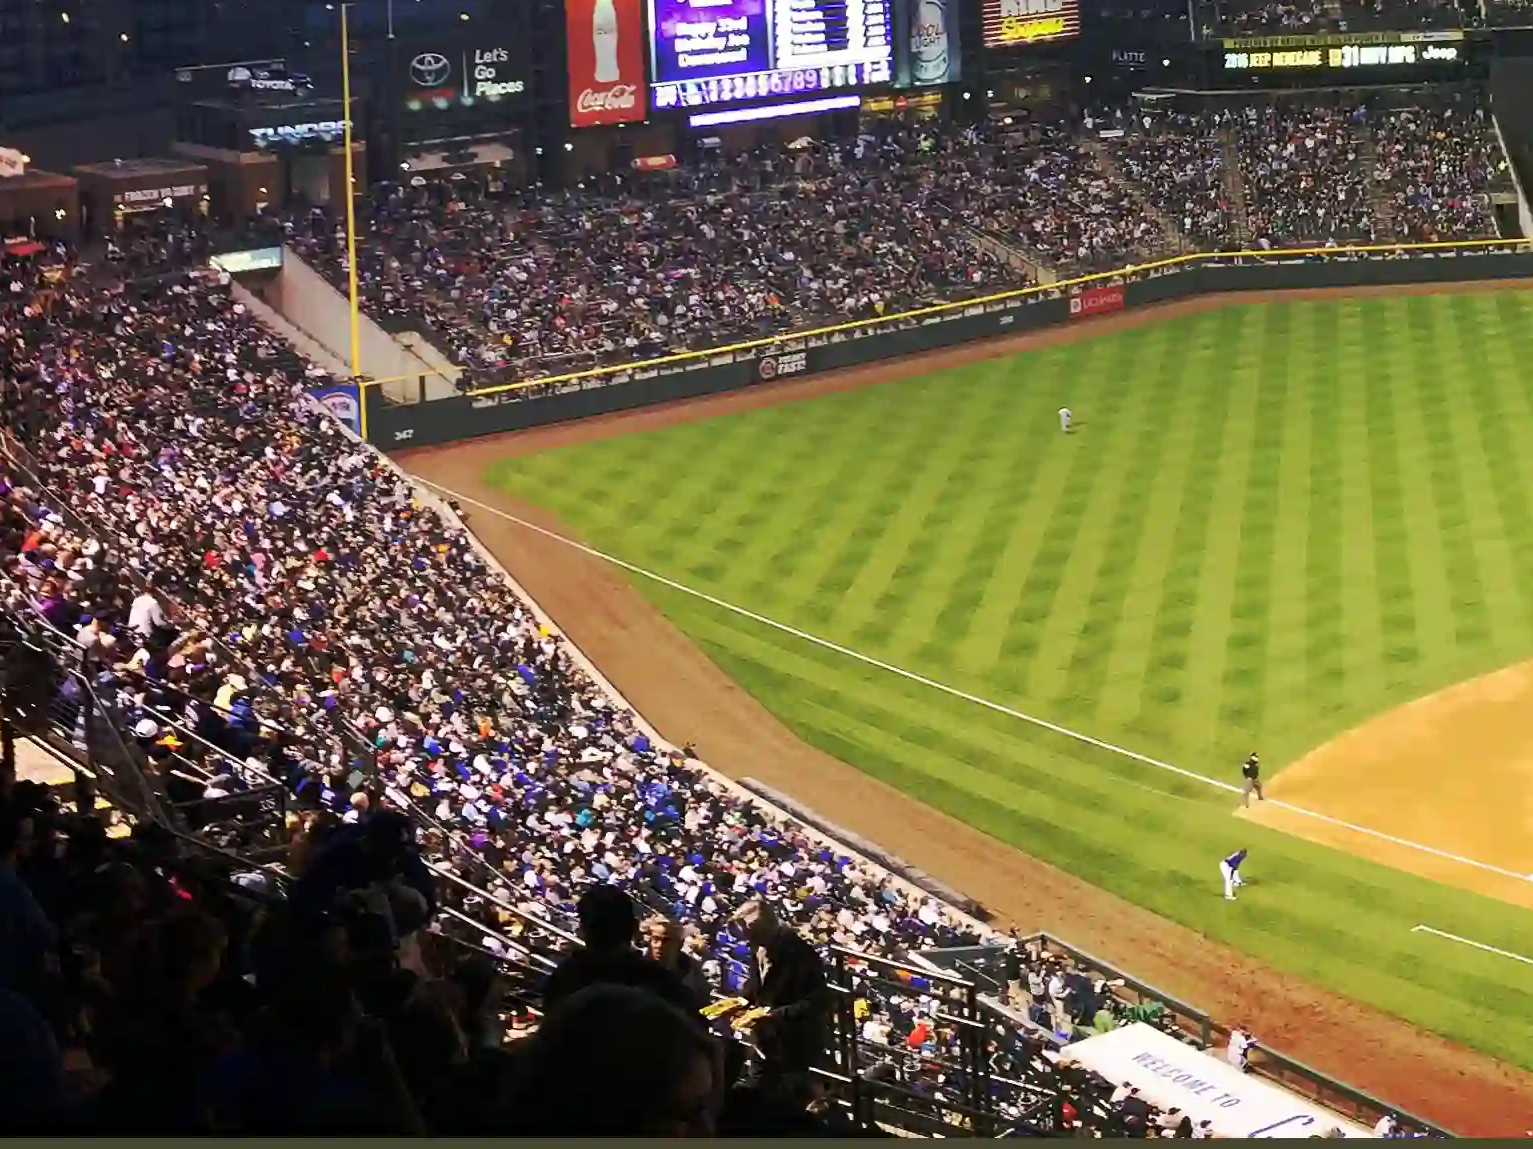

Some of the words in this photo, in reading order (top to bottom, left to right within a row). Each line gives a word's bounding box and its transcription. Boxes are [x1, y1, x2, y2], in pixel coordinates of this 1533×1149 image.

[475, 47, 509, 64] Let's
[475, 65, 496, 80] Go
[1131, 1051, 1216, 1096] WELCOME
[1211, 1092, 1241, 1108] TO
